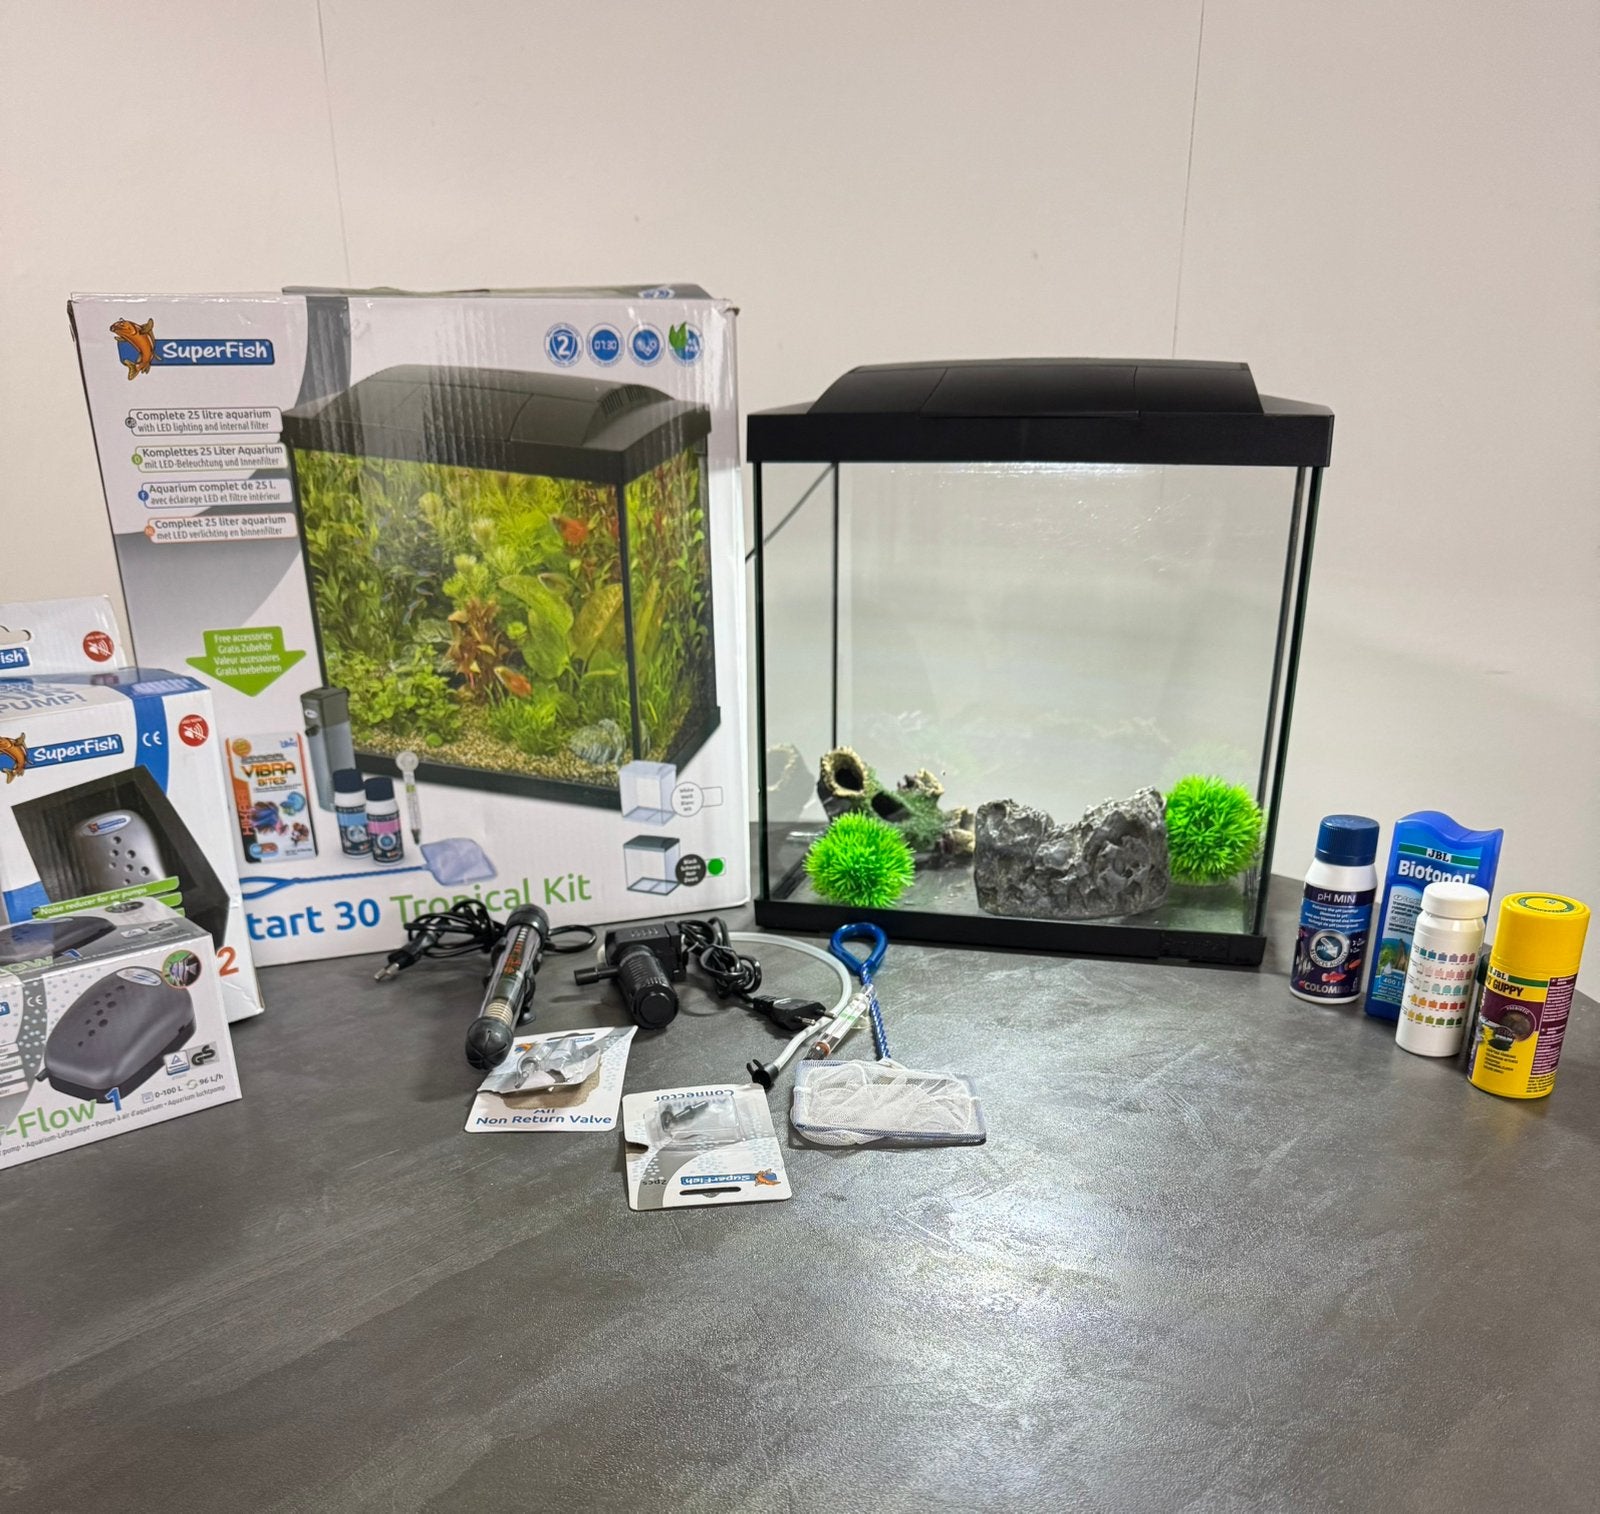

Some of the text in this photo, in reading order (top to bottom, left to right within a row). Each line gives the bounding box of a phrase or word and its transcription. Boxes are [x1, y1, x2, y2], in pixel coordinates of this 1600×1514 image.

[162, 341, 267, 361] SuperFish
[136, 410, 271, 421] Complete 25 litre aquarium
[138, 421, 269, 433] with LED lighting and internal filter
[143, 445, 283, 458] Komplettes 25 Liter Aquarium
[145, 457, 279, 470] mit LED-Beleuchtung und Innenfilter
[150, 484, 197, 495] Aquarium
[200, 482, 238, 493] complet
[242, 481, 253, 490] de
[256, 481, 267, 490] 25
[151, 497, 167, 505] avec
[204, 494, 218, 503] LED
[229, 493, 247, 502] filtre
[155, 516, 286, 530] Compleet 25 liter aquarium
[157, 527, 282, 540] met LED verlichting en binnenfilter
[214, 632, 273, 643] Free accessories
[218, 645, 240, 654] Gratis
[216, 667, 238, 676] Gratis
[33, 738, 118, 762] SuperFish
[240, 762, 296, 778] VIBRA
[1427, 850, 1450, 863] JBL
[1317, 893, 1356, 904] pH MIN
[41, 903, 64, 915] Noise
[66, 898, 95, 911] reducer
[247, 873, 591, 941] tart 30 Troical Kit
[218, 946, 239, 978] 2
[1493, 979, 1524, 997] GUPPY
[155, 1087, 177, 1098] 0-100
[654, 1089, 734, 1102] Connector
[105, 1087, 122, 1112] 1
[476, 1114, 612, 1125] Non Return Valve
[685, 1175, 751, 1185] SuperFish
